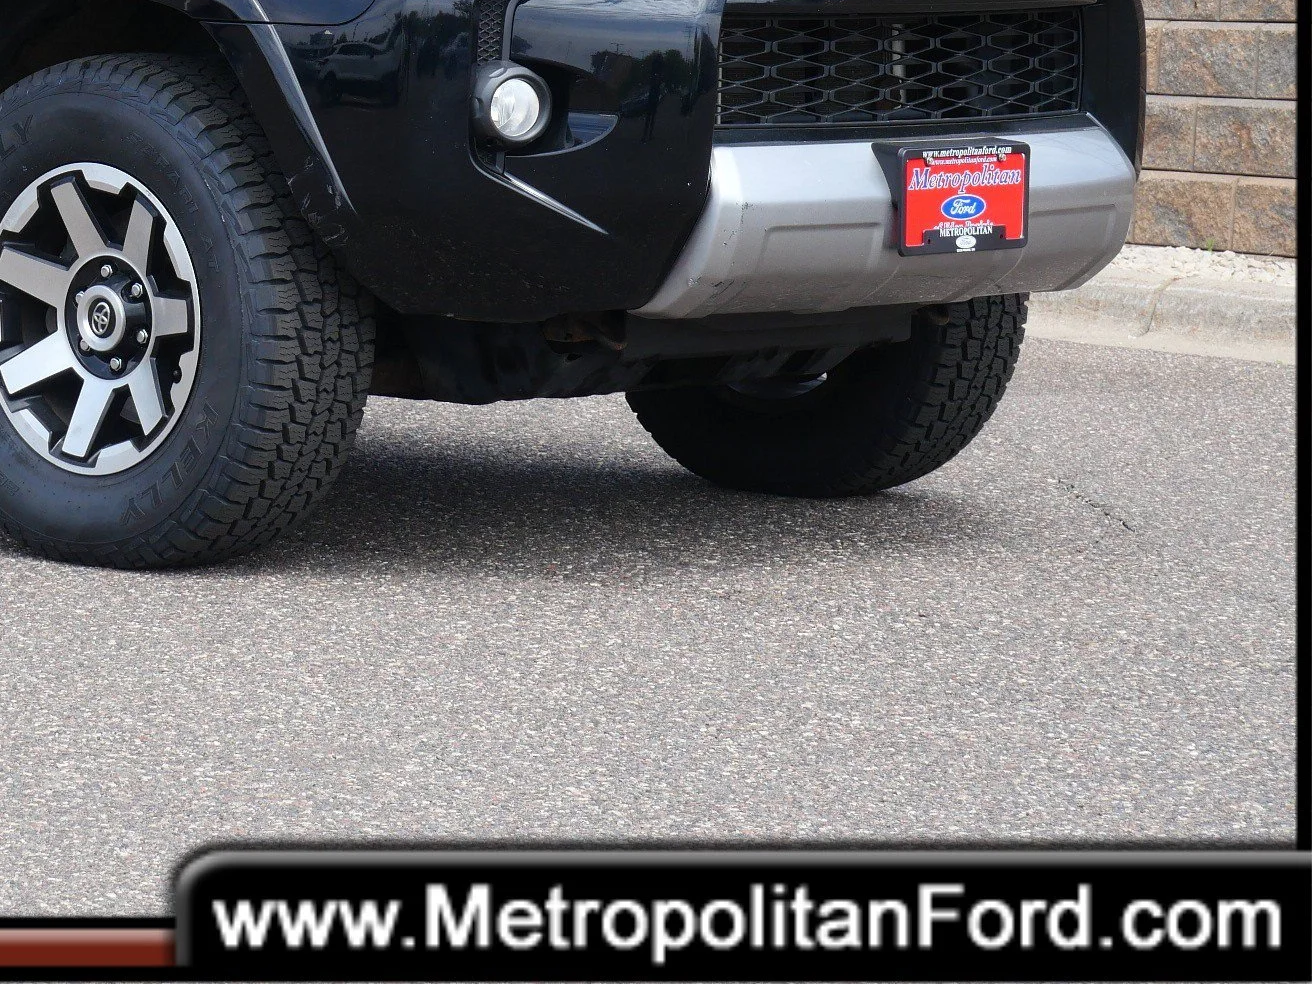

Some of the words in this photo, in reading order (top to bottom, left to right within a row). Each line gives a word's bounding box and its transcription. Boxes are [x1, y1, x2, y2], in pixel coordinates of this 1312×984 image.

[922, 145, 1012, 159] www.metropolitanford.com
[907, 163, 1022, 194] Metropolitan
[950, 198, 977, 215] Ford
[939, 226, 993, 238] METROPOLITAN
[120, 397, 221, 527] KELLY
